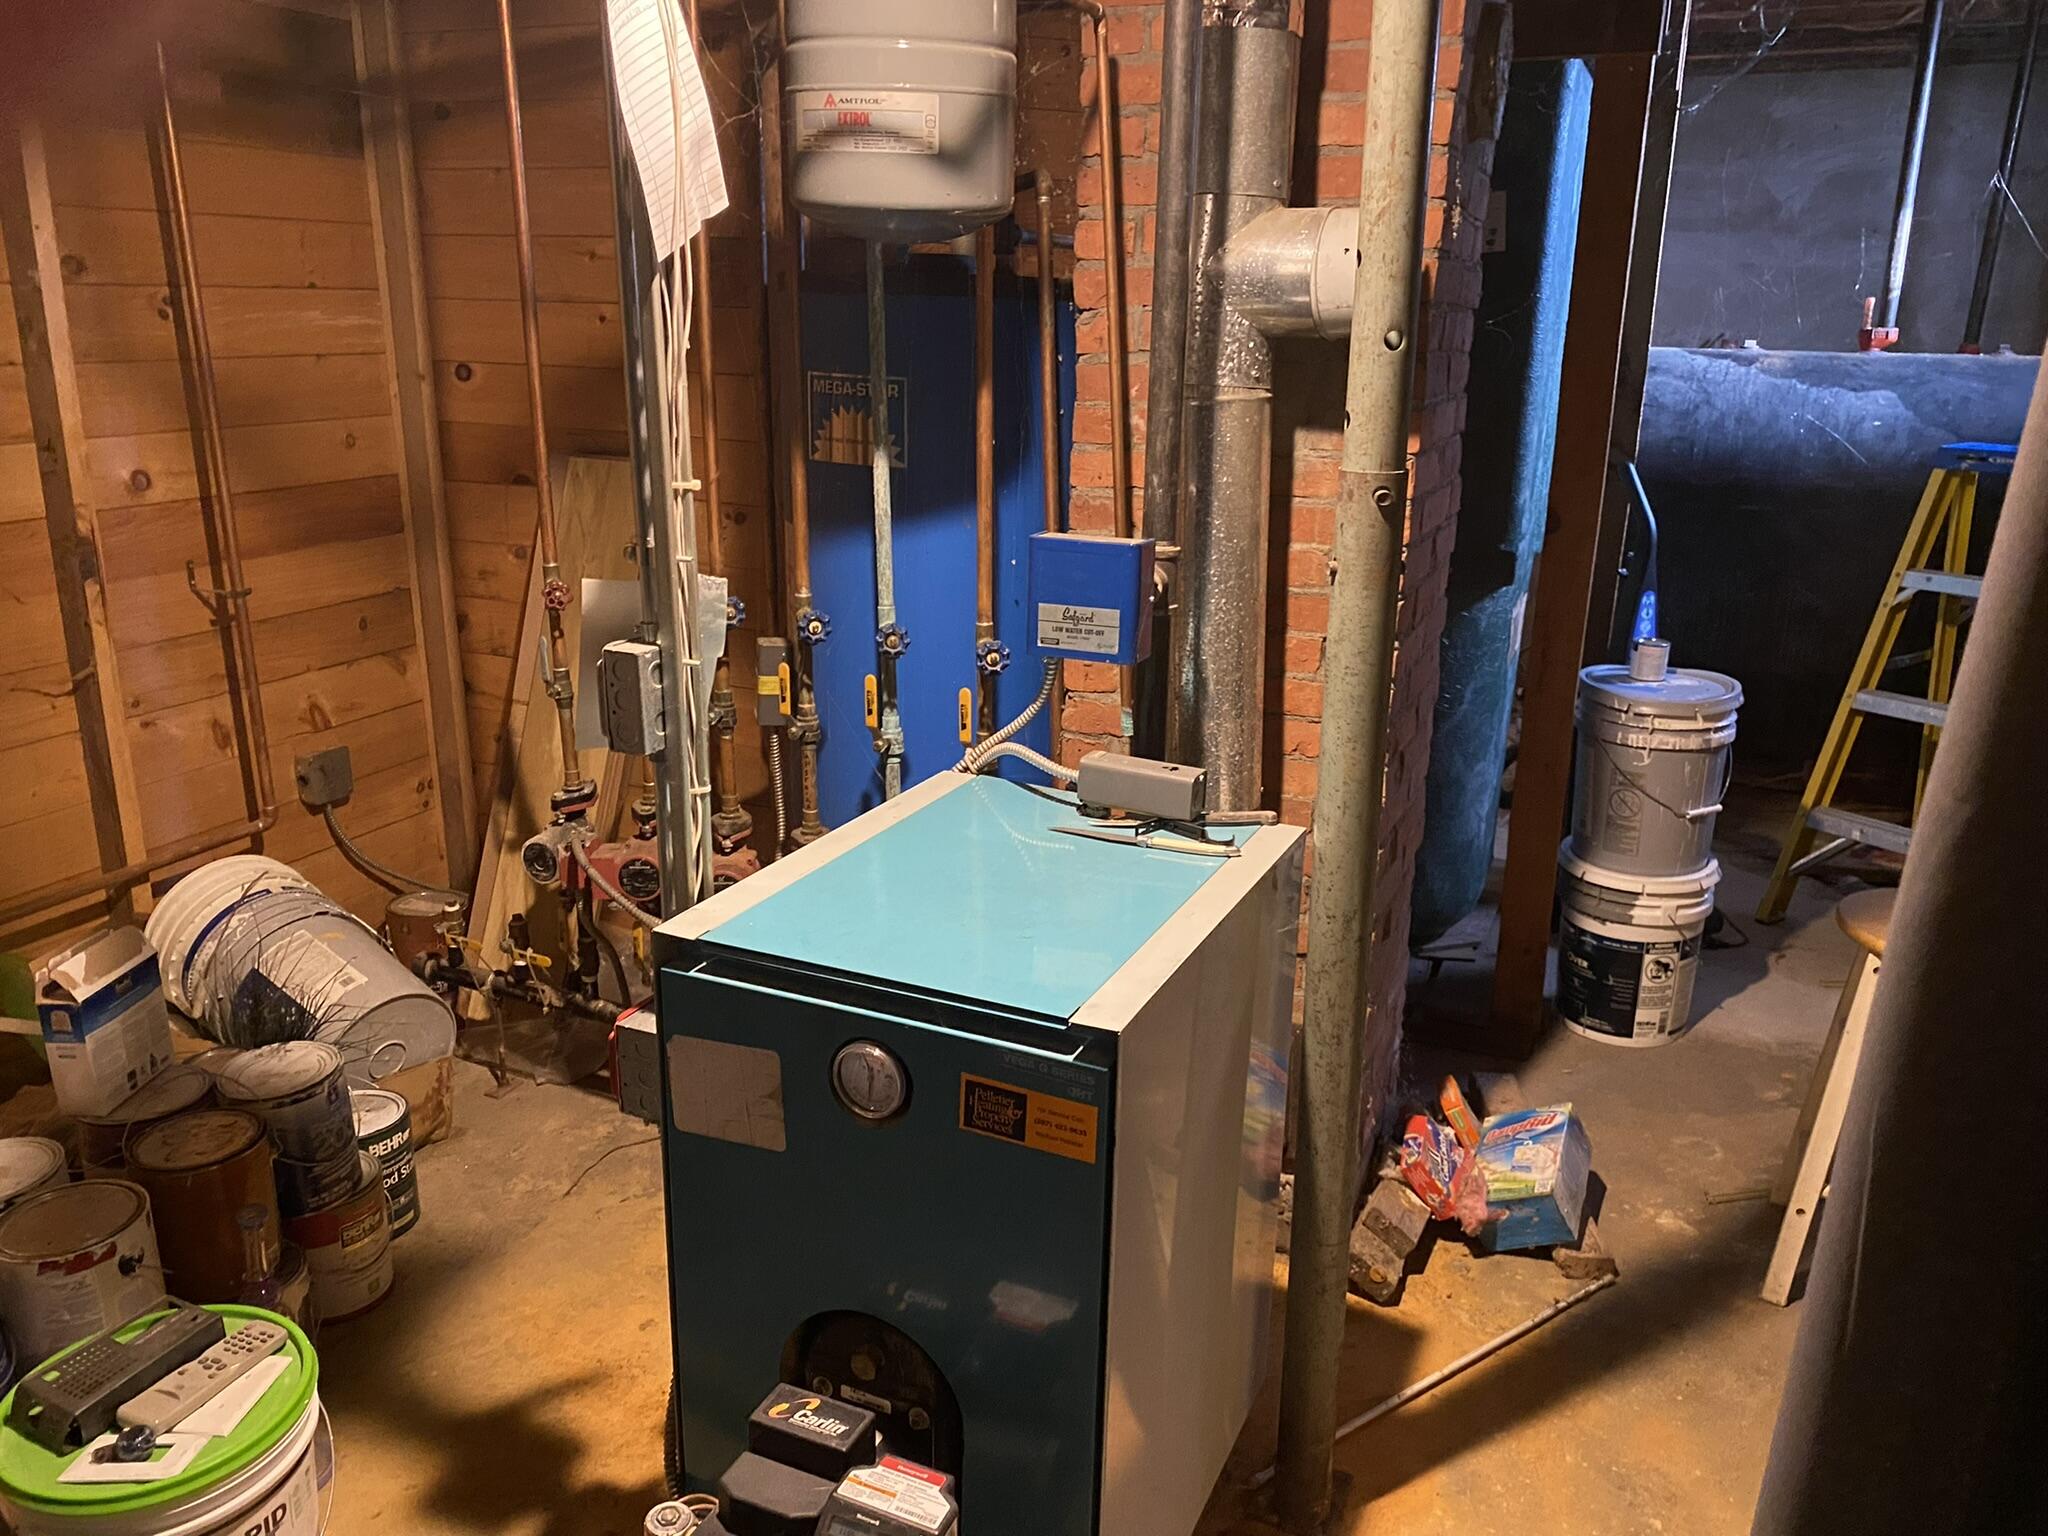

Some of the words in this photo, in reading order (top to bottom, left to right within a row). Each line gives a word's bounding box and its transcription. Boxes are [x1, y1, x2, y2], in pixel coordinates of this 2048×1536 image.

[837, 97, 883, 105] AMTROL
[836, 111, 872, 127] EXTROL
[811, 379, 899, 398] MEGA-STR
[1051, 626, 1064, 634] LOW
[1065, 627, 1083, 636] WATER
[368, 1132, 403, 1158] BEHR
[793, 1409, 847, 1435] Carlin
